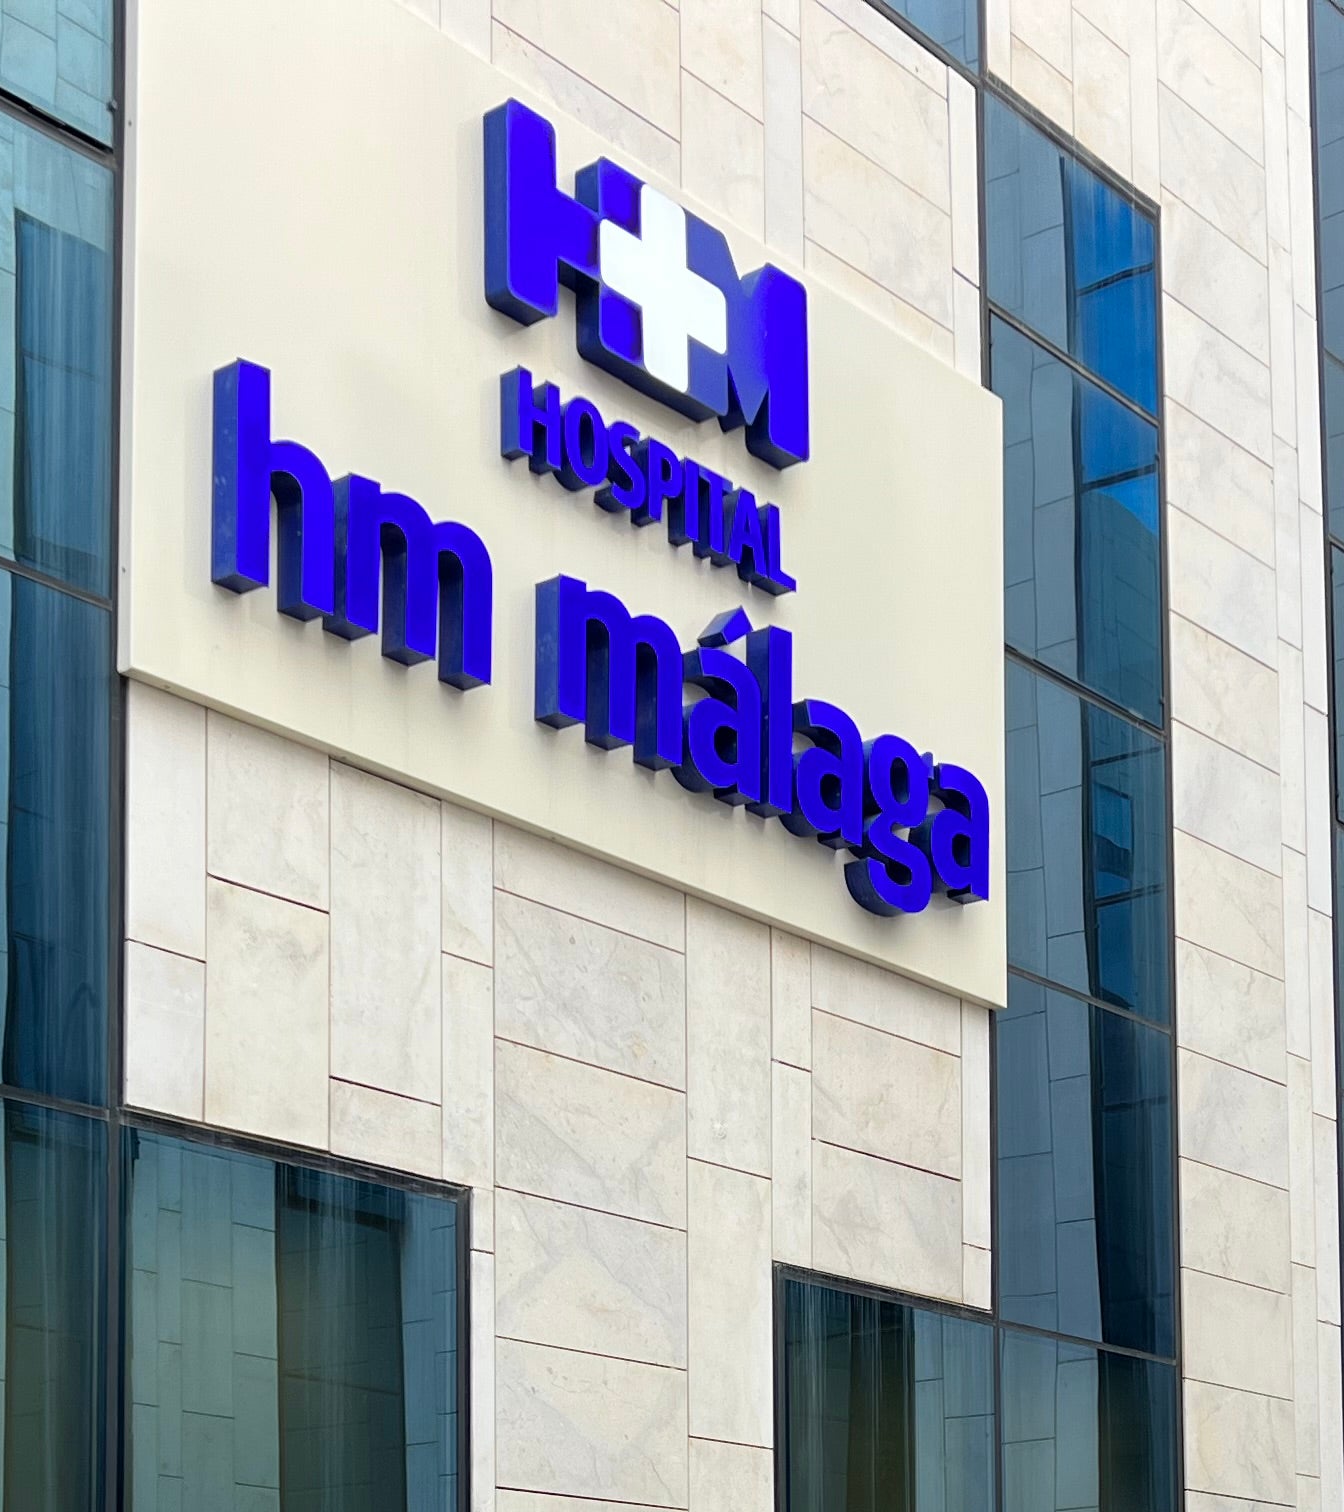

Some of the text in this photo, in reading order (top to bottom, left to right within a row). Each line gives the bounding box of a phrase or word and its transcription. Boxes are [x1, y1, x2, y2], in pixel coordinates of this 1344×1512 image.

[211, 357, 990, 916] hm málaga
[500, 365, 797, 596] HOSPITAL
